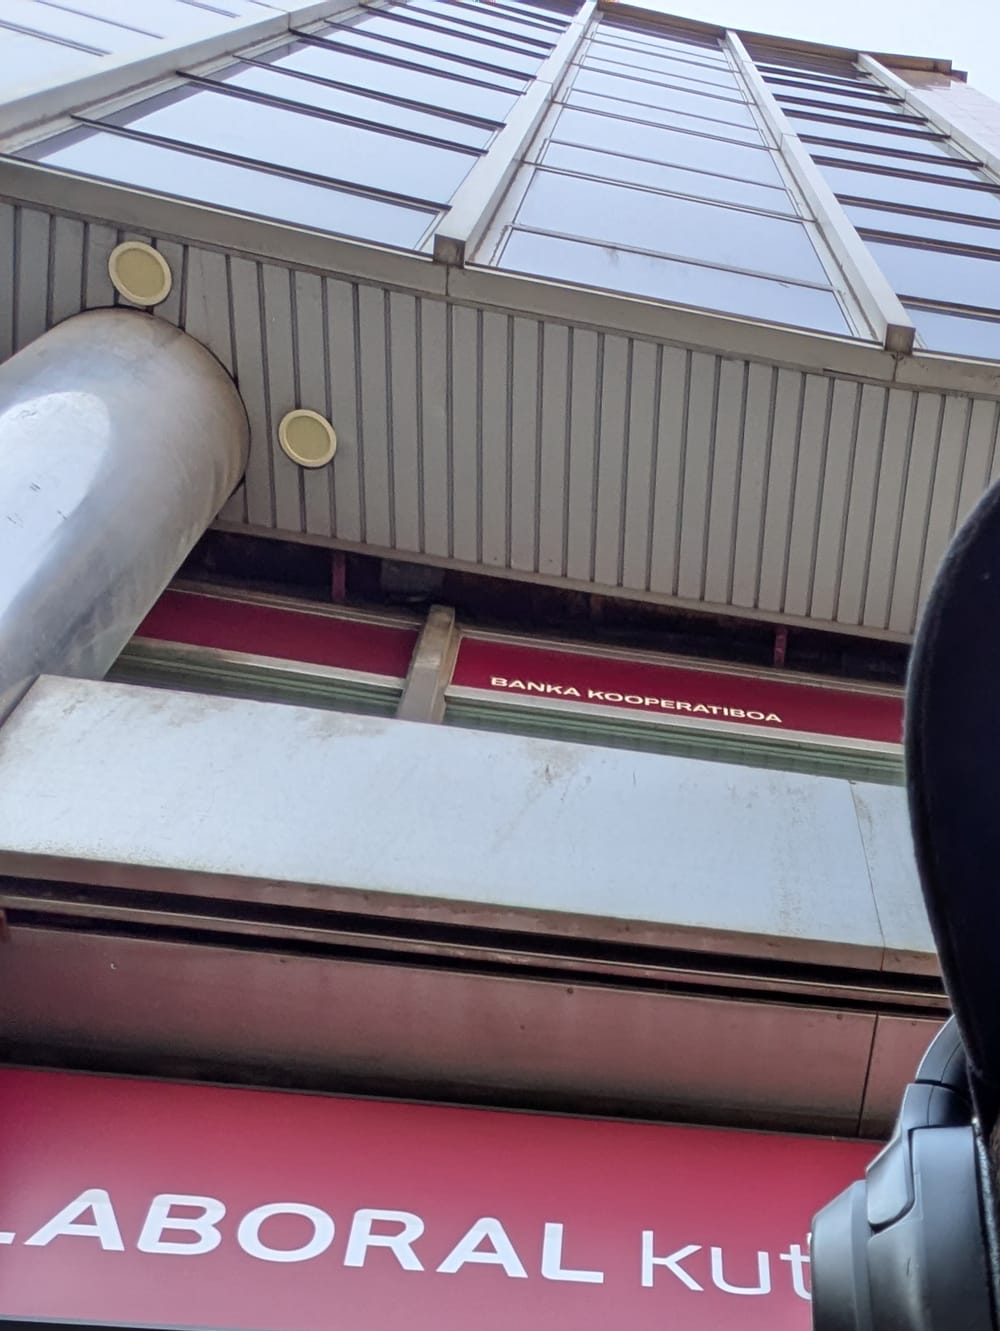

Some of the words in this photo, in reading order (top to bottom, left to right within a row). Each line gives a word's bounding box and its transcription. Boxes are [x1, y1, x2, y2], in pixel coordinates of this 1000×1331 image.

[490, 676, 581, 698] BANKA
[587, 689, 783, 723] KOOPERATIBOA
[0, 1188, 605, 1284] ABORAL
[641, 1229, 813, 1301] kut
